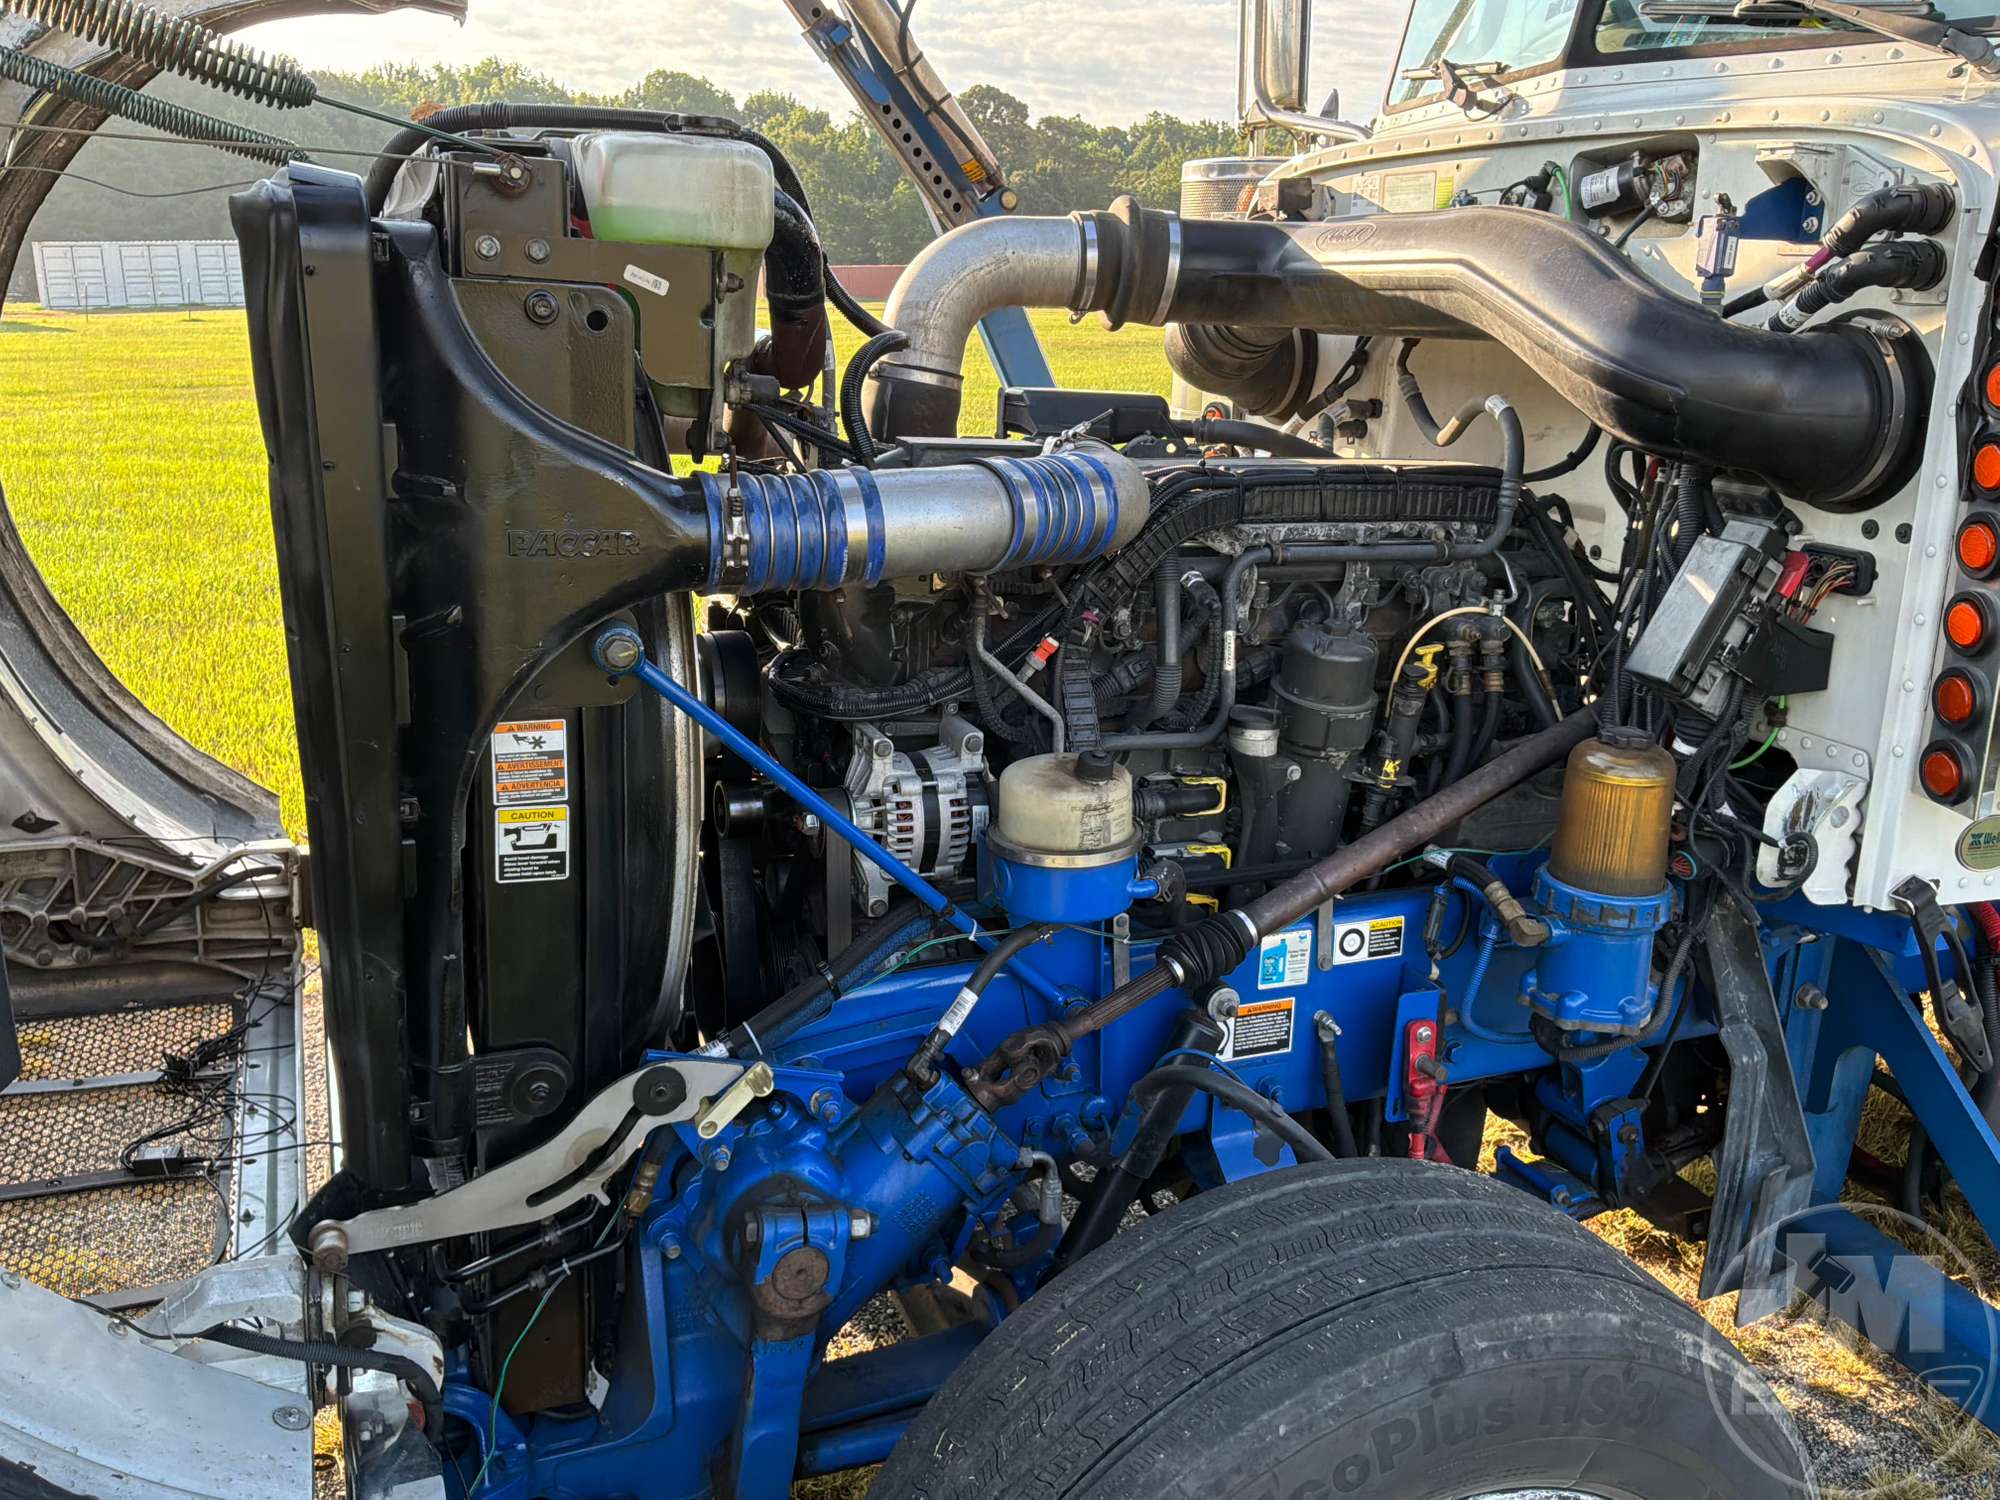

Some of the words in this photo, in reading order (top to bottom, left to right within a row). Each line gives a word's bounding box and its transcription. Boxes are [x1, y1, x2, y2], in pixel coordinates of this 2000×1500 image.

[505, 529, 641, 558] PACCAR
[516, 722, 551, 731] WARNING
[507, 760, 563, 770] AVERTISSEMENT
[511, 781, 560, 790] ADVERTENCIA
[510, 810, 555, 821] CAUTION
[1375, 919, 1403, 928] CAUTION
[1251, 1002, 1282, 1013] WARNING
